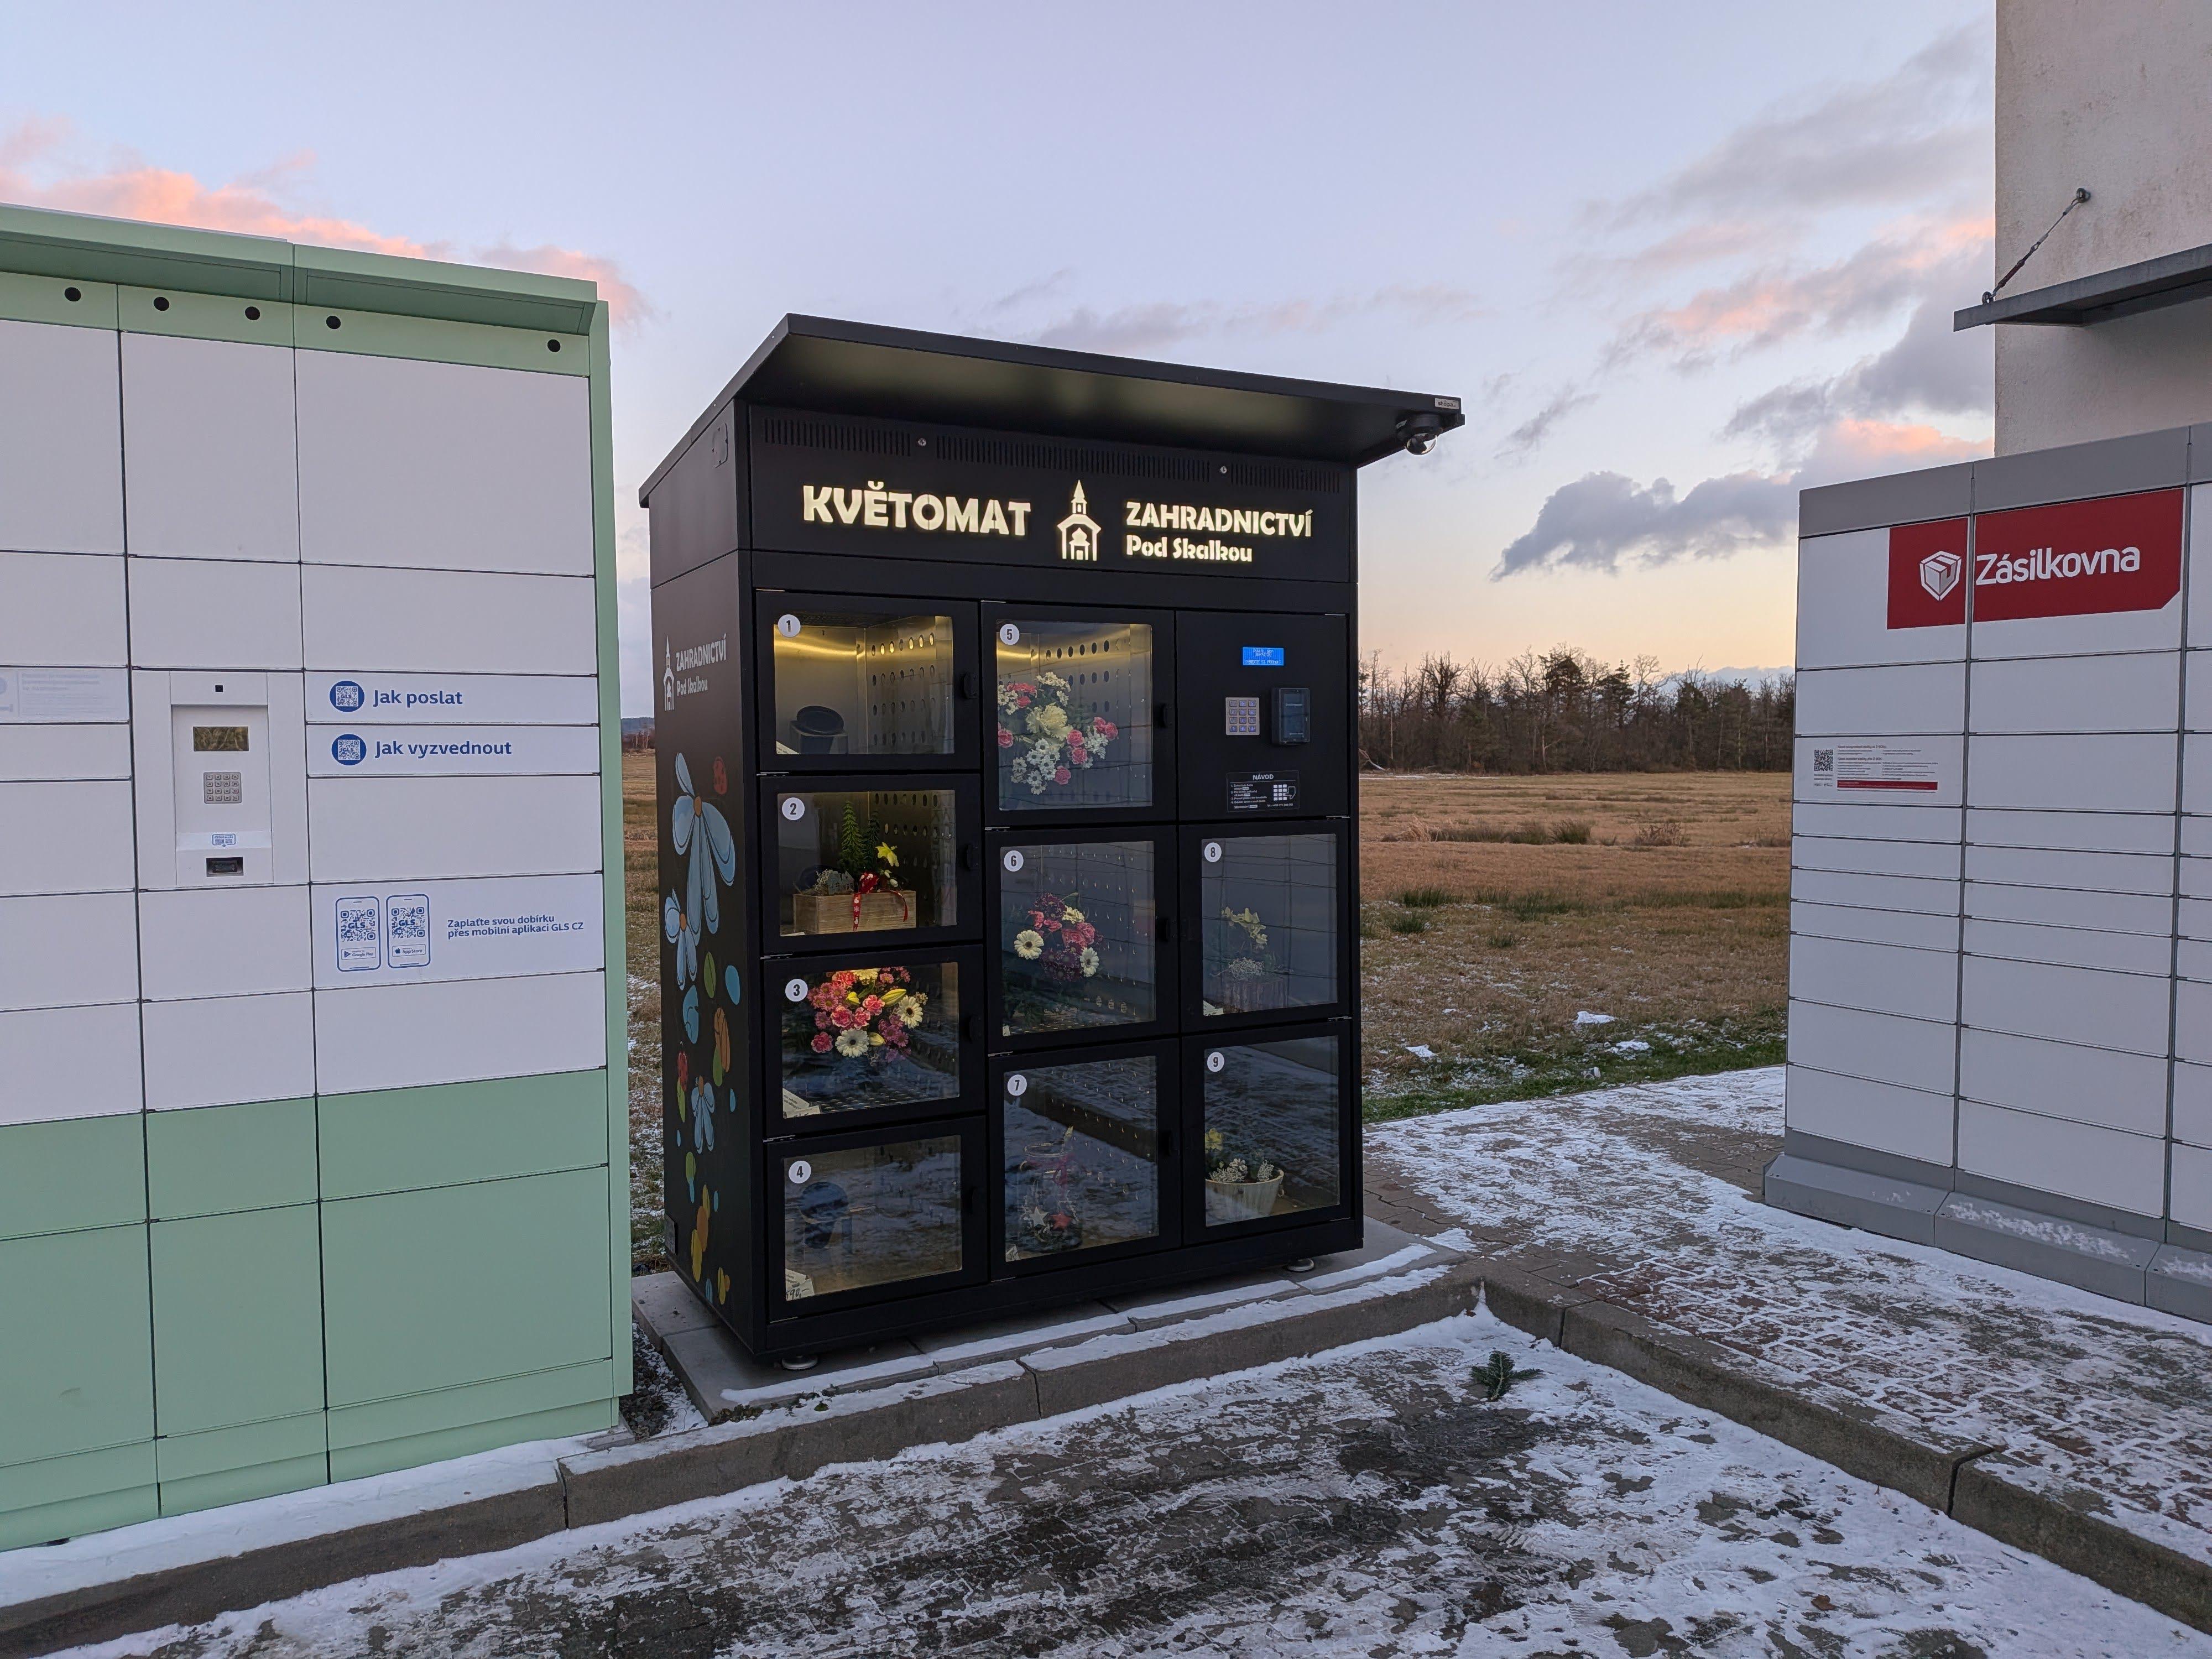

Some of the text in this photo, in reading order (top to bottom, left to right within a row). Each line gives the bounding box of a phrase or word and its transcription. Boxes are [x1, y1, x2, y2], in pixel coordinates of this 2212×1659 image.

[802, 480, 1032, 536] KVĚTOMAT
[1125, 500, 1313, 538] ZAHRADNICTVÍ
[1126, 534, 1253, 562] Pod Skalkou
[1975, 546, 2140, 586] Zásilkovna
[786, 620, 791, 632] 1
[1007, 629, 1012, 640] 5
[676, 633, 726, 671] ZAHRADNICTVÍ
[677, 676, 708, 696] Pod Skalkou
[373, 689, 463, 708] Jak poslat
[375, 741, 512, 759] Jak vyzvednout
[790, 803, 796, 815] 2
[1211, 847, 1215, 857] 8
[1011, 855, 1016, 867] 6
[348, 921, 366, 930] GLS
[447, 917, 490, 928] Zaplaťte
[518, 914, 555, 924] dobírku
[447, 922, 584, 940] přes mobilní aplikaci GLS CZ
[794, 984, 800, 996] 3
[1213, 1057, 1218, 1067] 9
[1015, 1079, 1020, 1091] 7
[796, 1166, 804, 1177] 4
